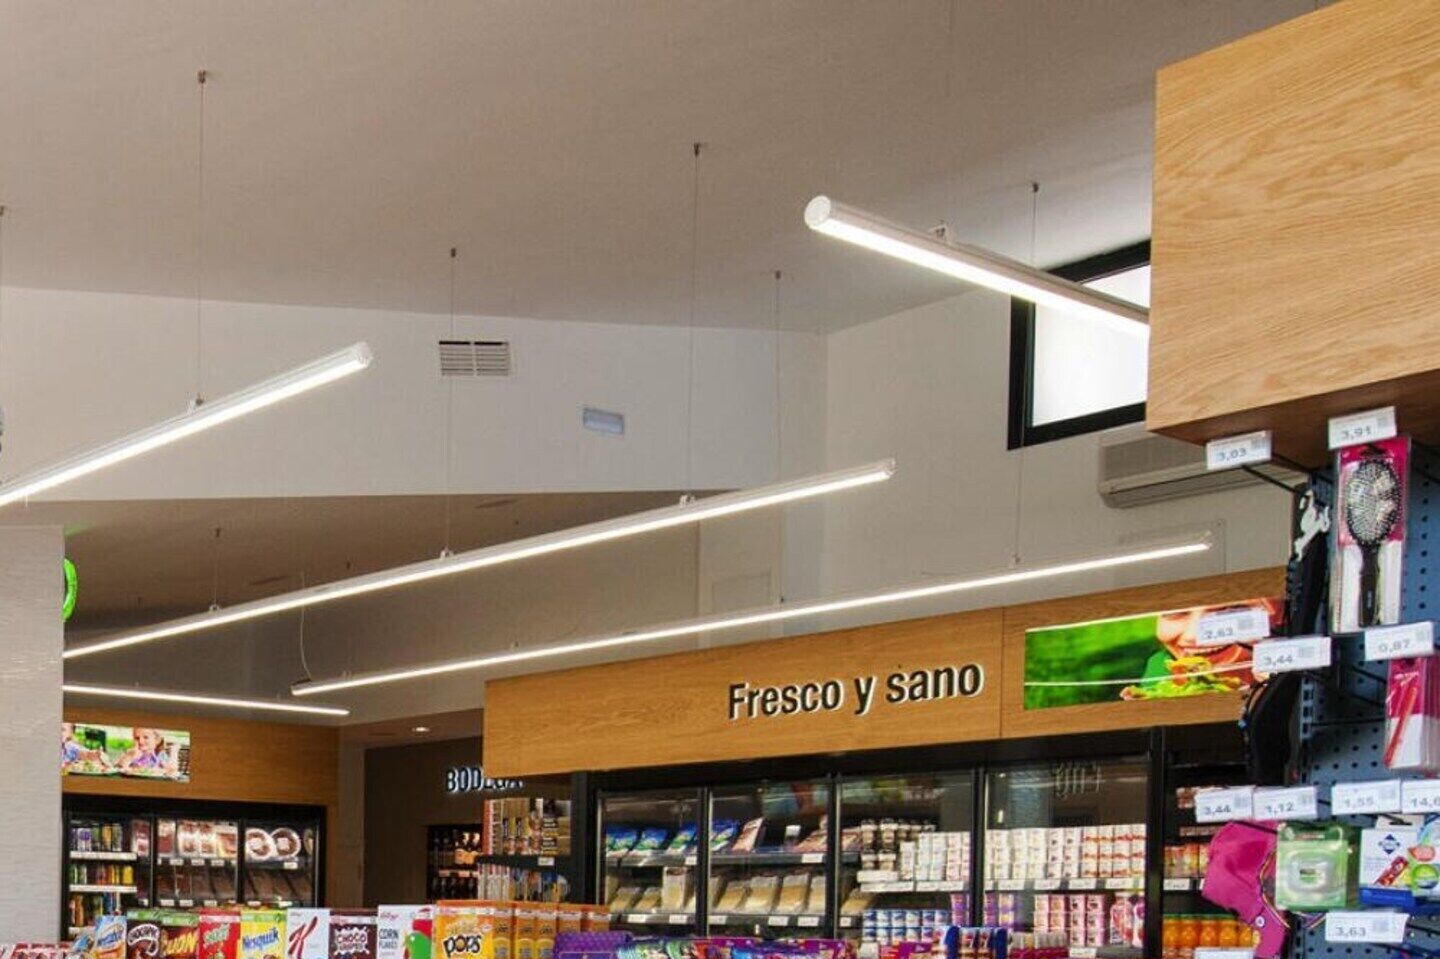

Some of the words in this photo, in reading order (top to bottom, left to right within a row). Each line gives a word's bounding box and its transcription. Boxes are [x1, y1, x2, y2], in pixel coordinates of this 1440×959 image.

[728, 680, 844, 720] Fresco
[854, 675, 878, 716] y
[885, 663, 986, 704] sano
